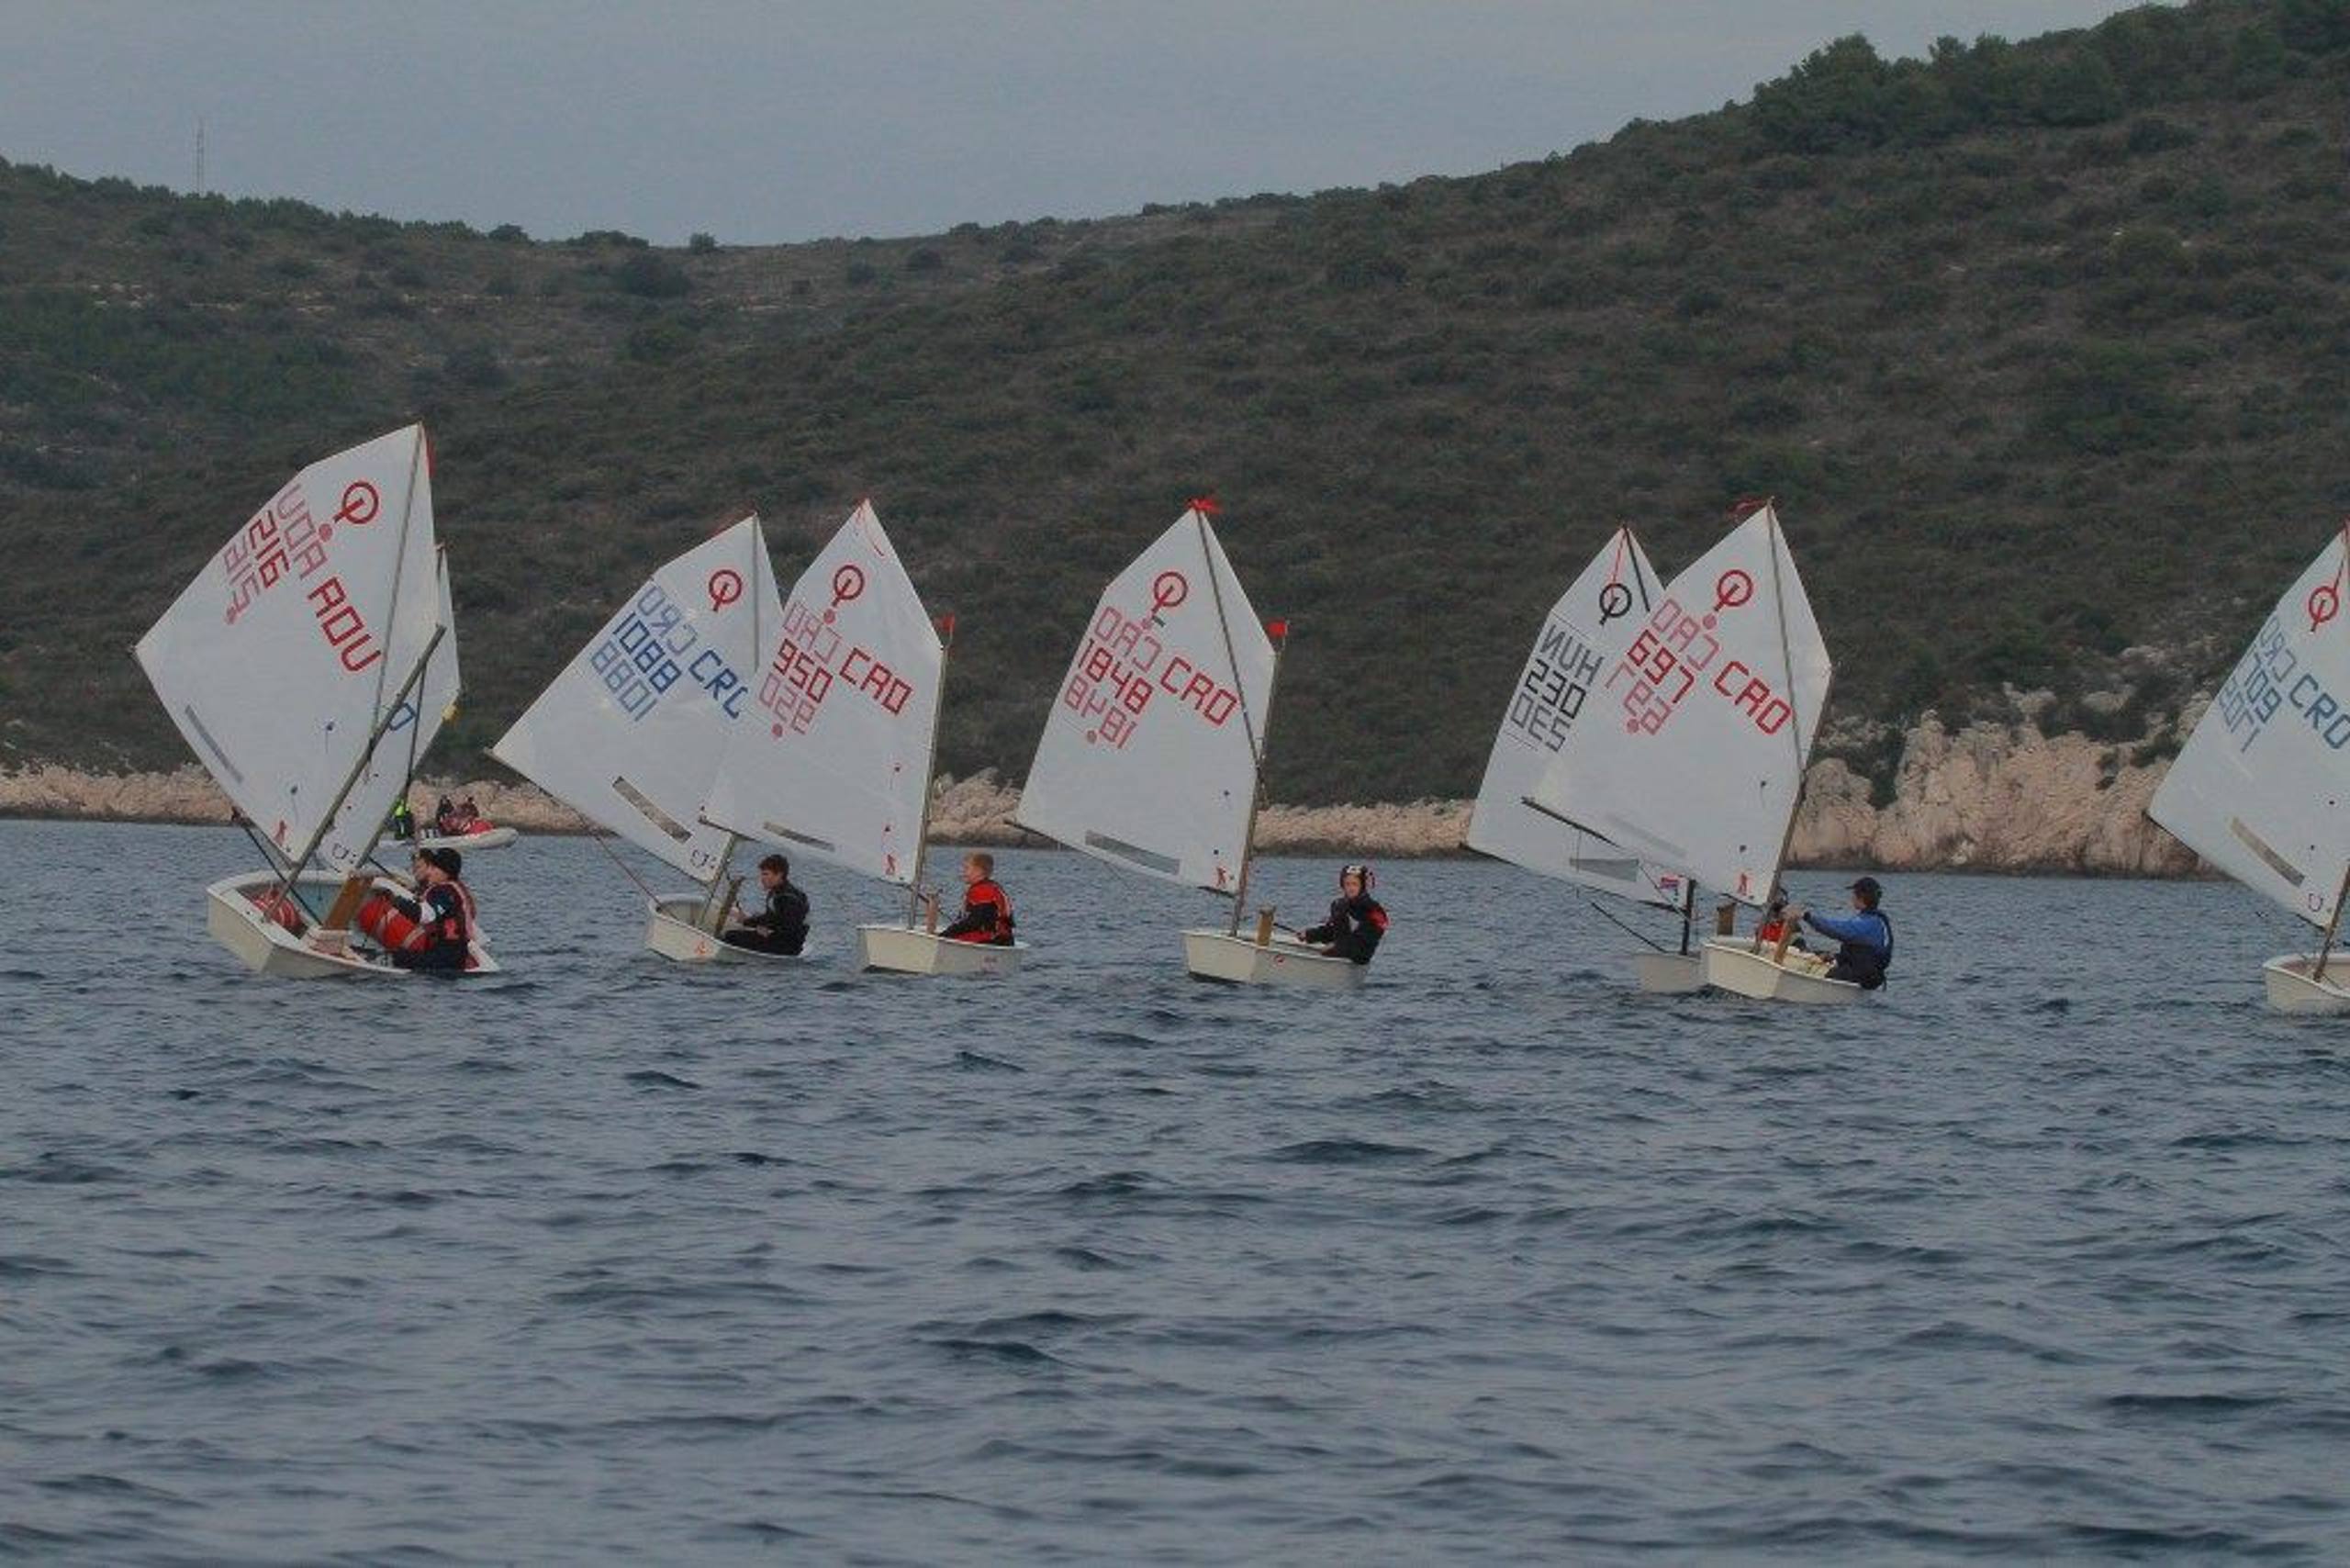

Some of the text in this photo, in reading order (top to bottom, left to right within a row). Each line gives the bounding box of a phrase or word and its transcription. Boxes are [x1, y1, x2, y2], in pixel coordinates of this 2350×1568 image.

[249, 510, 290, 588] 216
[613, 612, 682, 694] 1088
[772, 638, 834, 704] 950
[1078, 638, 1153, 715] 1848
[1525, 657, 1586, 721] 230
[1627, 629, 1695, 704] 697
